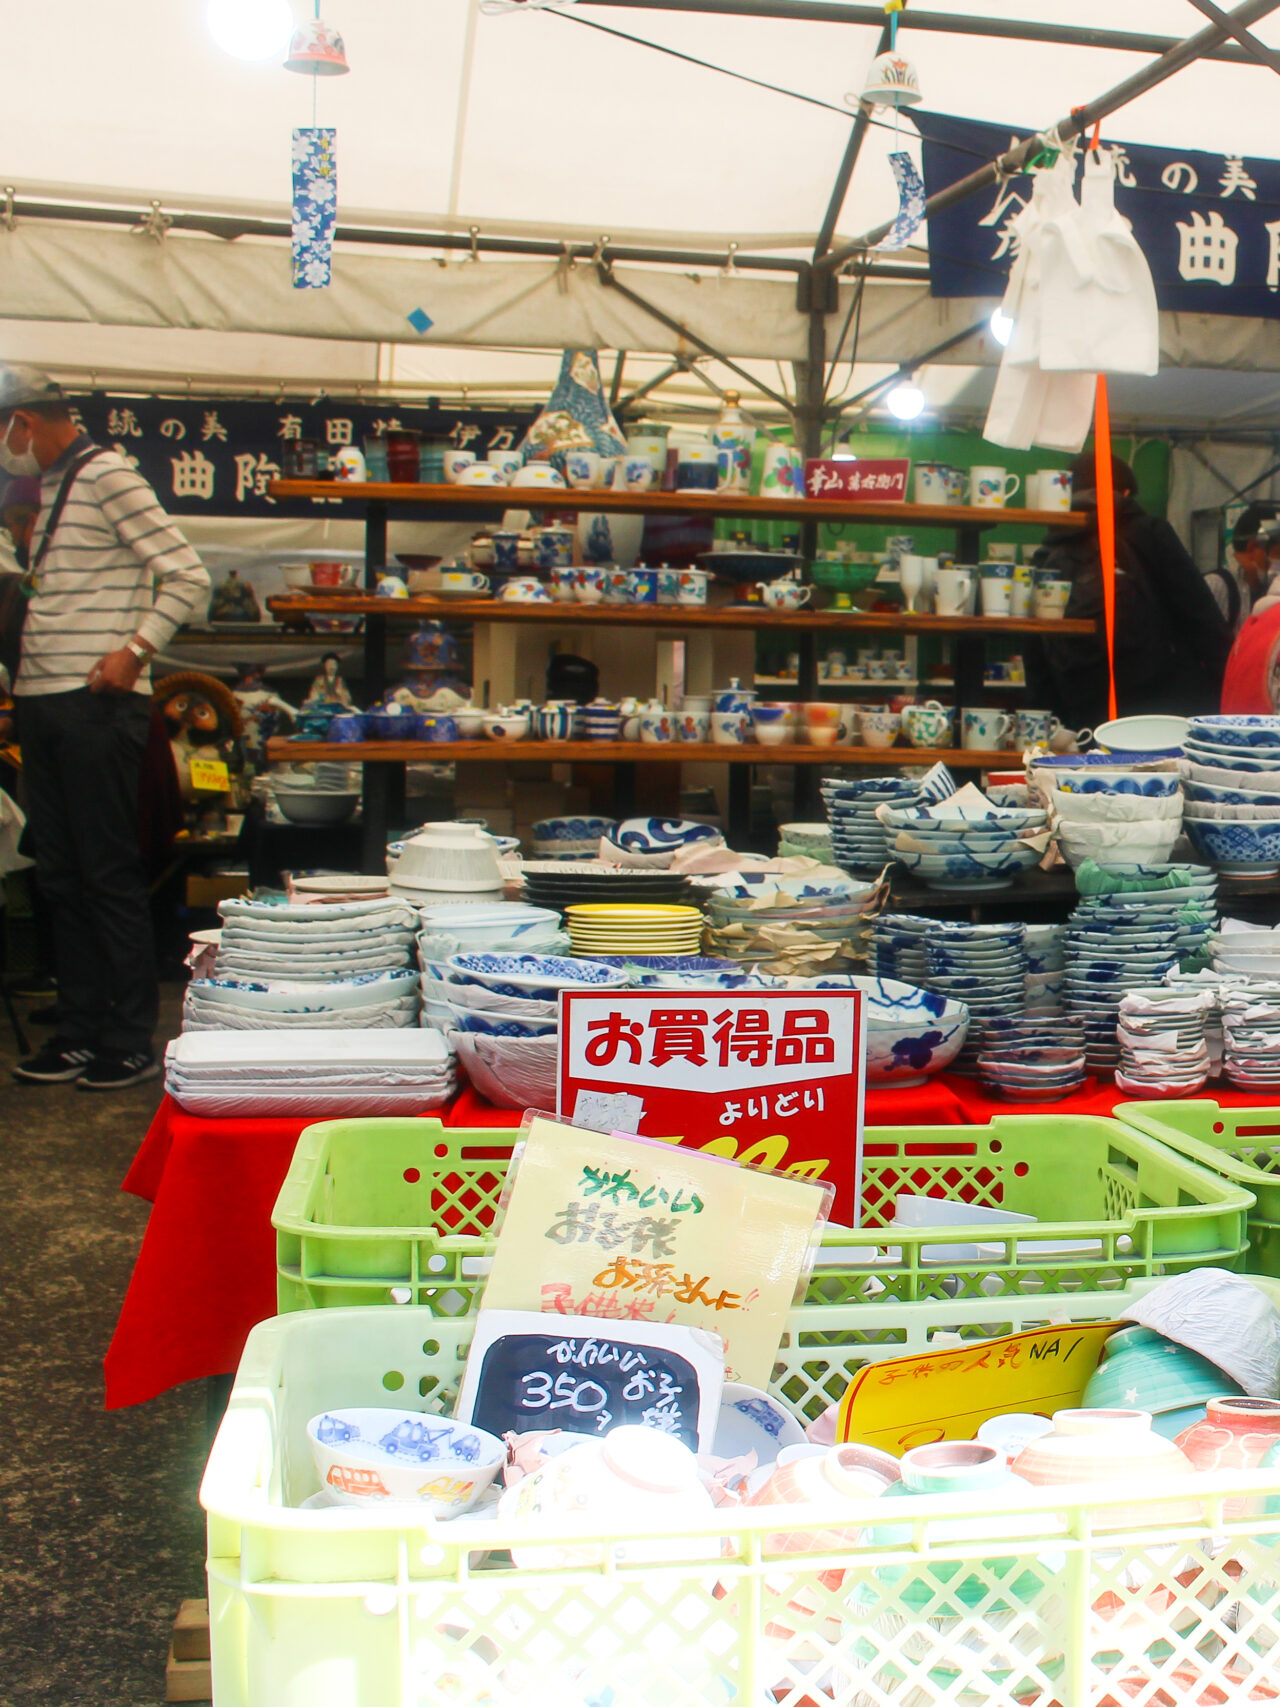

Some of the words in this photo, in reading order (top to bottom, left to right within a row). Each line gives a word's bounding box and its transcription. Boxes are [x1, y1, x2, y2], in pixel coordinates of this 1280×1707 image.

[585, 1009, 835, 1067] お買得品
[718, 1087, 825, 1126] よりどり
[578, 1165, 705, 1214] かわいい
